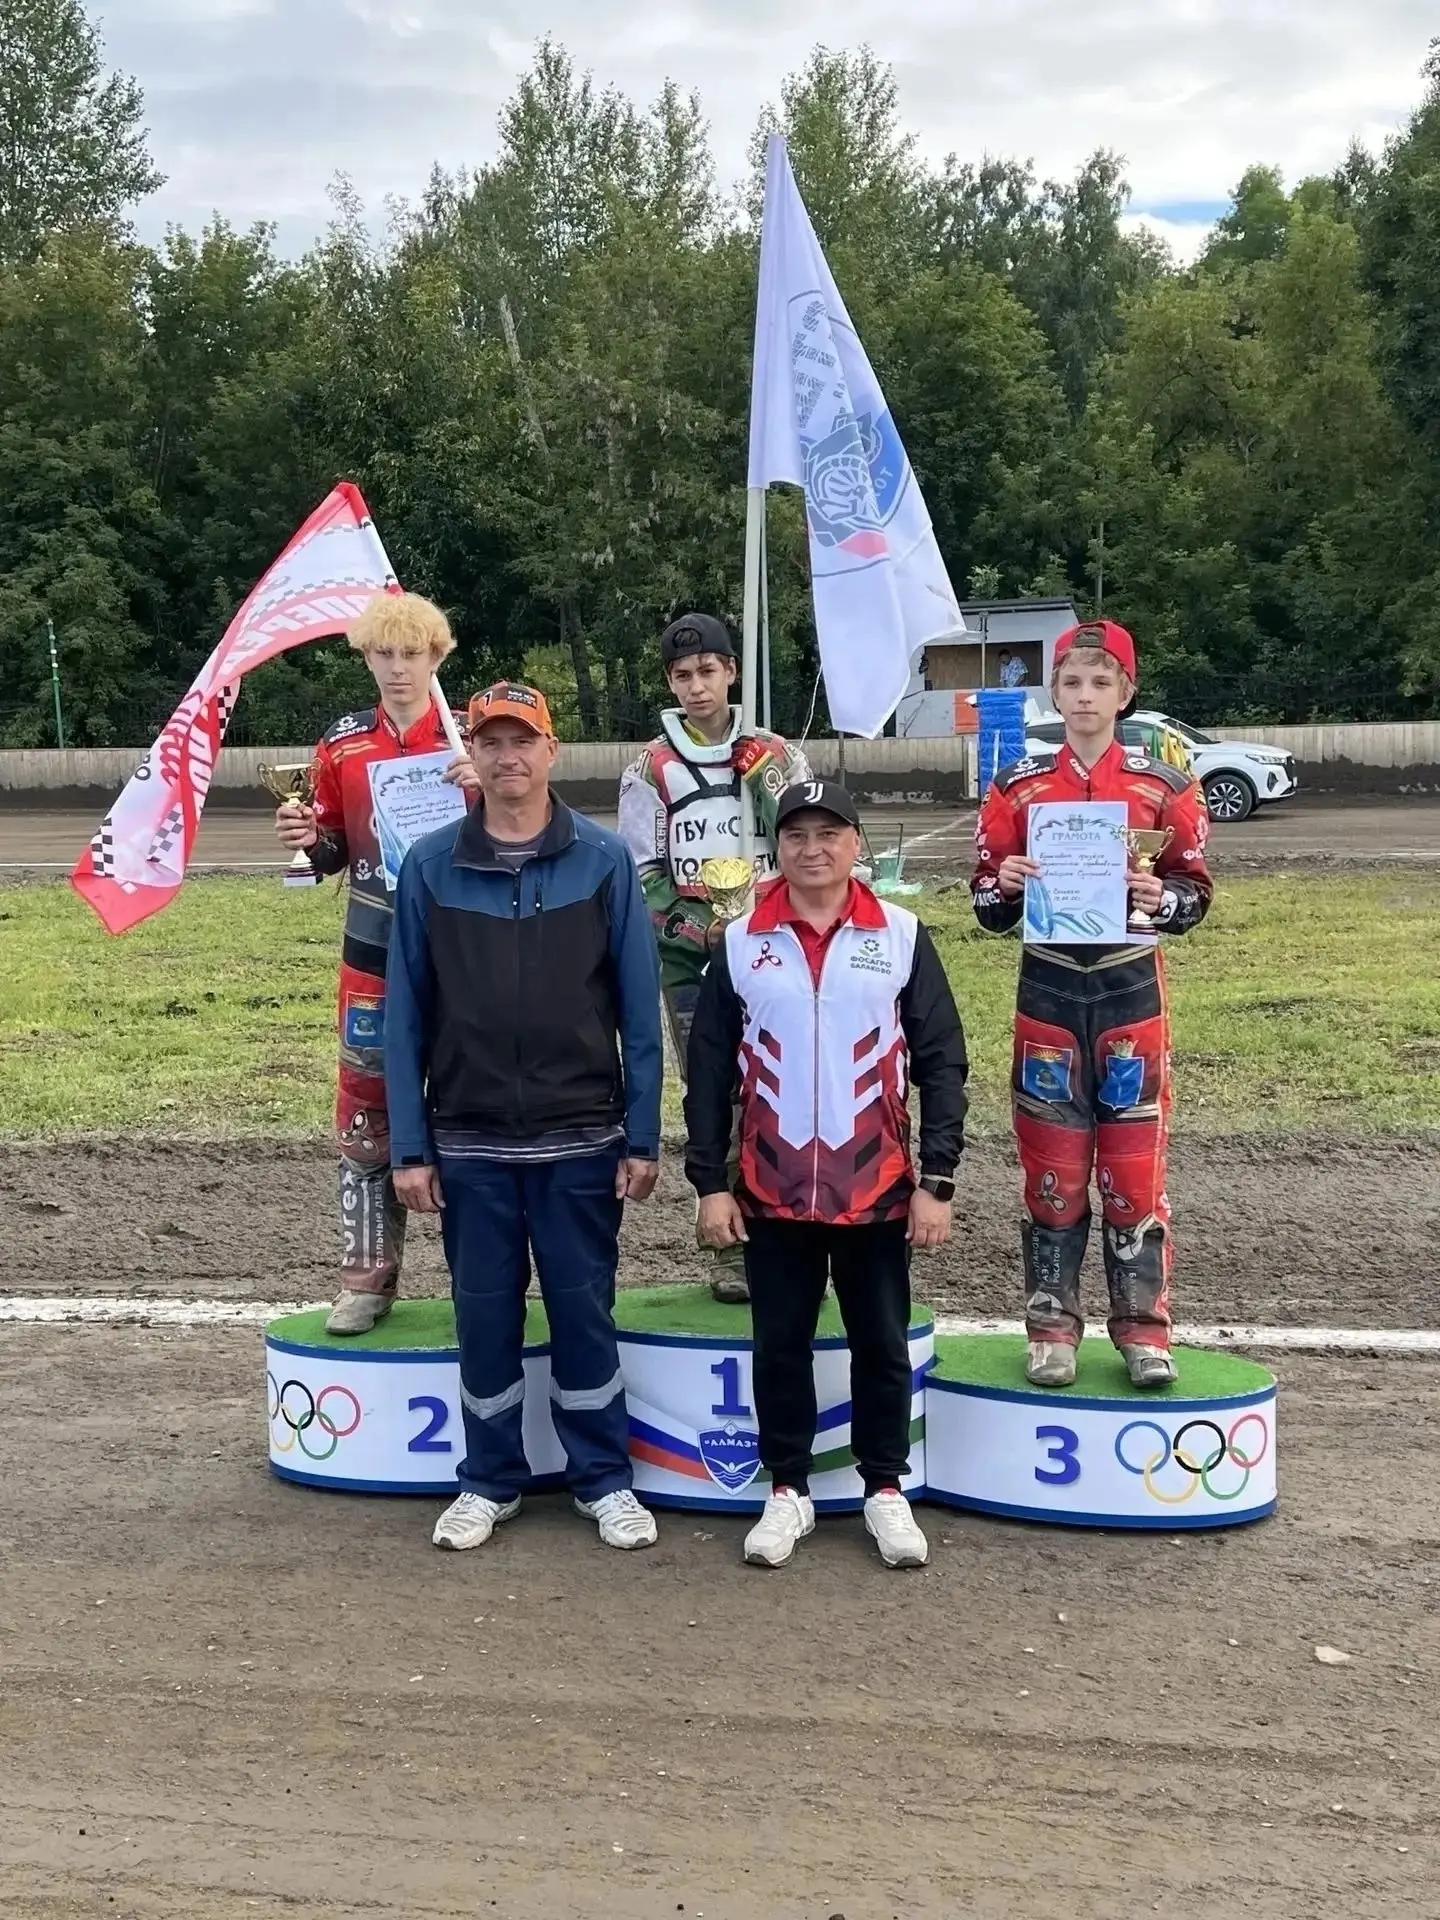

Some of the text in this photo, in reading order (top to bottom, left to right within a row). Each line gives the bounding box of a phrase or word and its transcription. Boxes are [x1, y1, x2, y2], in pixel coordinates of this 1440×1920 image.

[675, 818, 707, 844] ГБУ
[1052, 832, 1101, 841] ГРАМОТА
[850, 956, 892, 968] ФОСАГРО
[850, 963, 892, 975] БАЛАКОВО
[711, 1357, 751, 1416] 1
[408, 1396, 452, 1452] 2
[1035, 1425, 1081, 1485] 3
